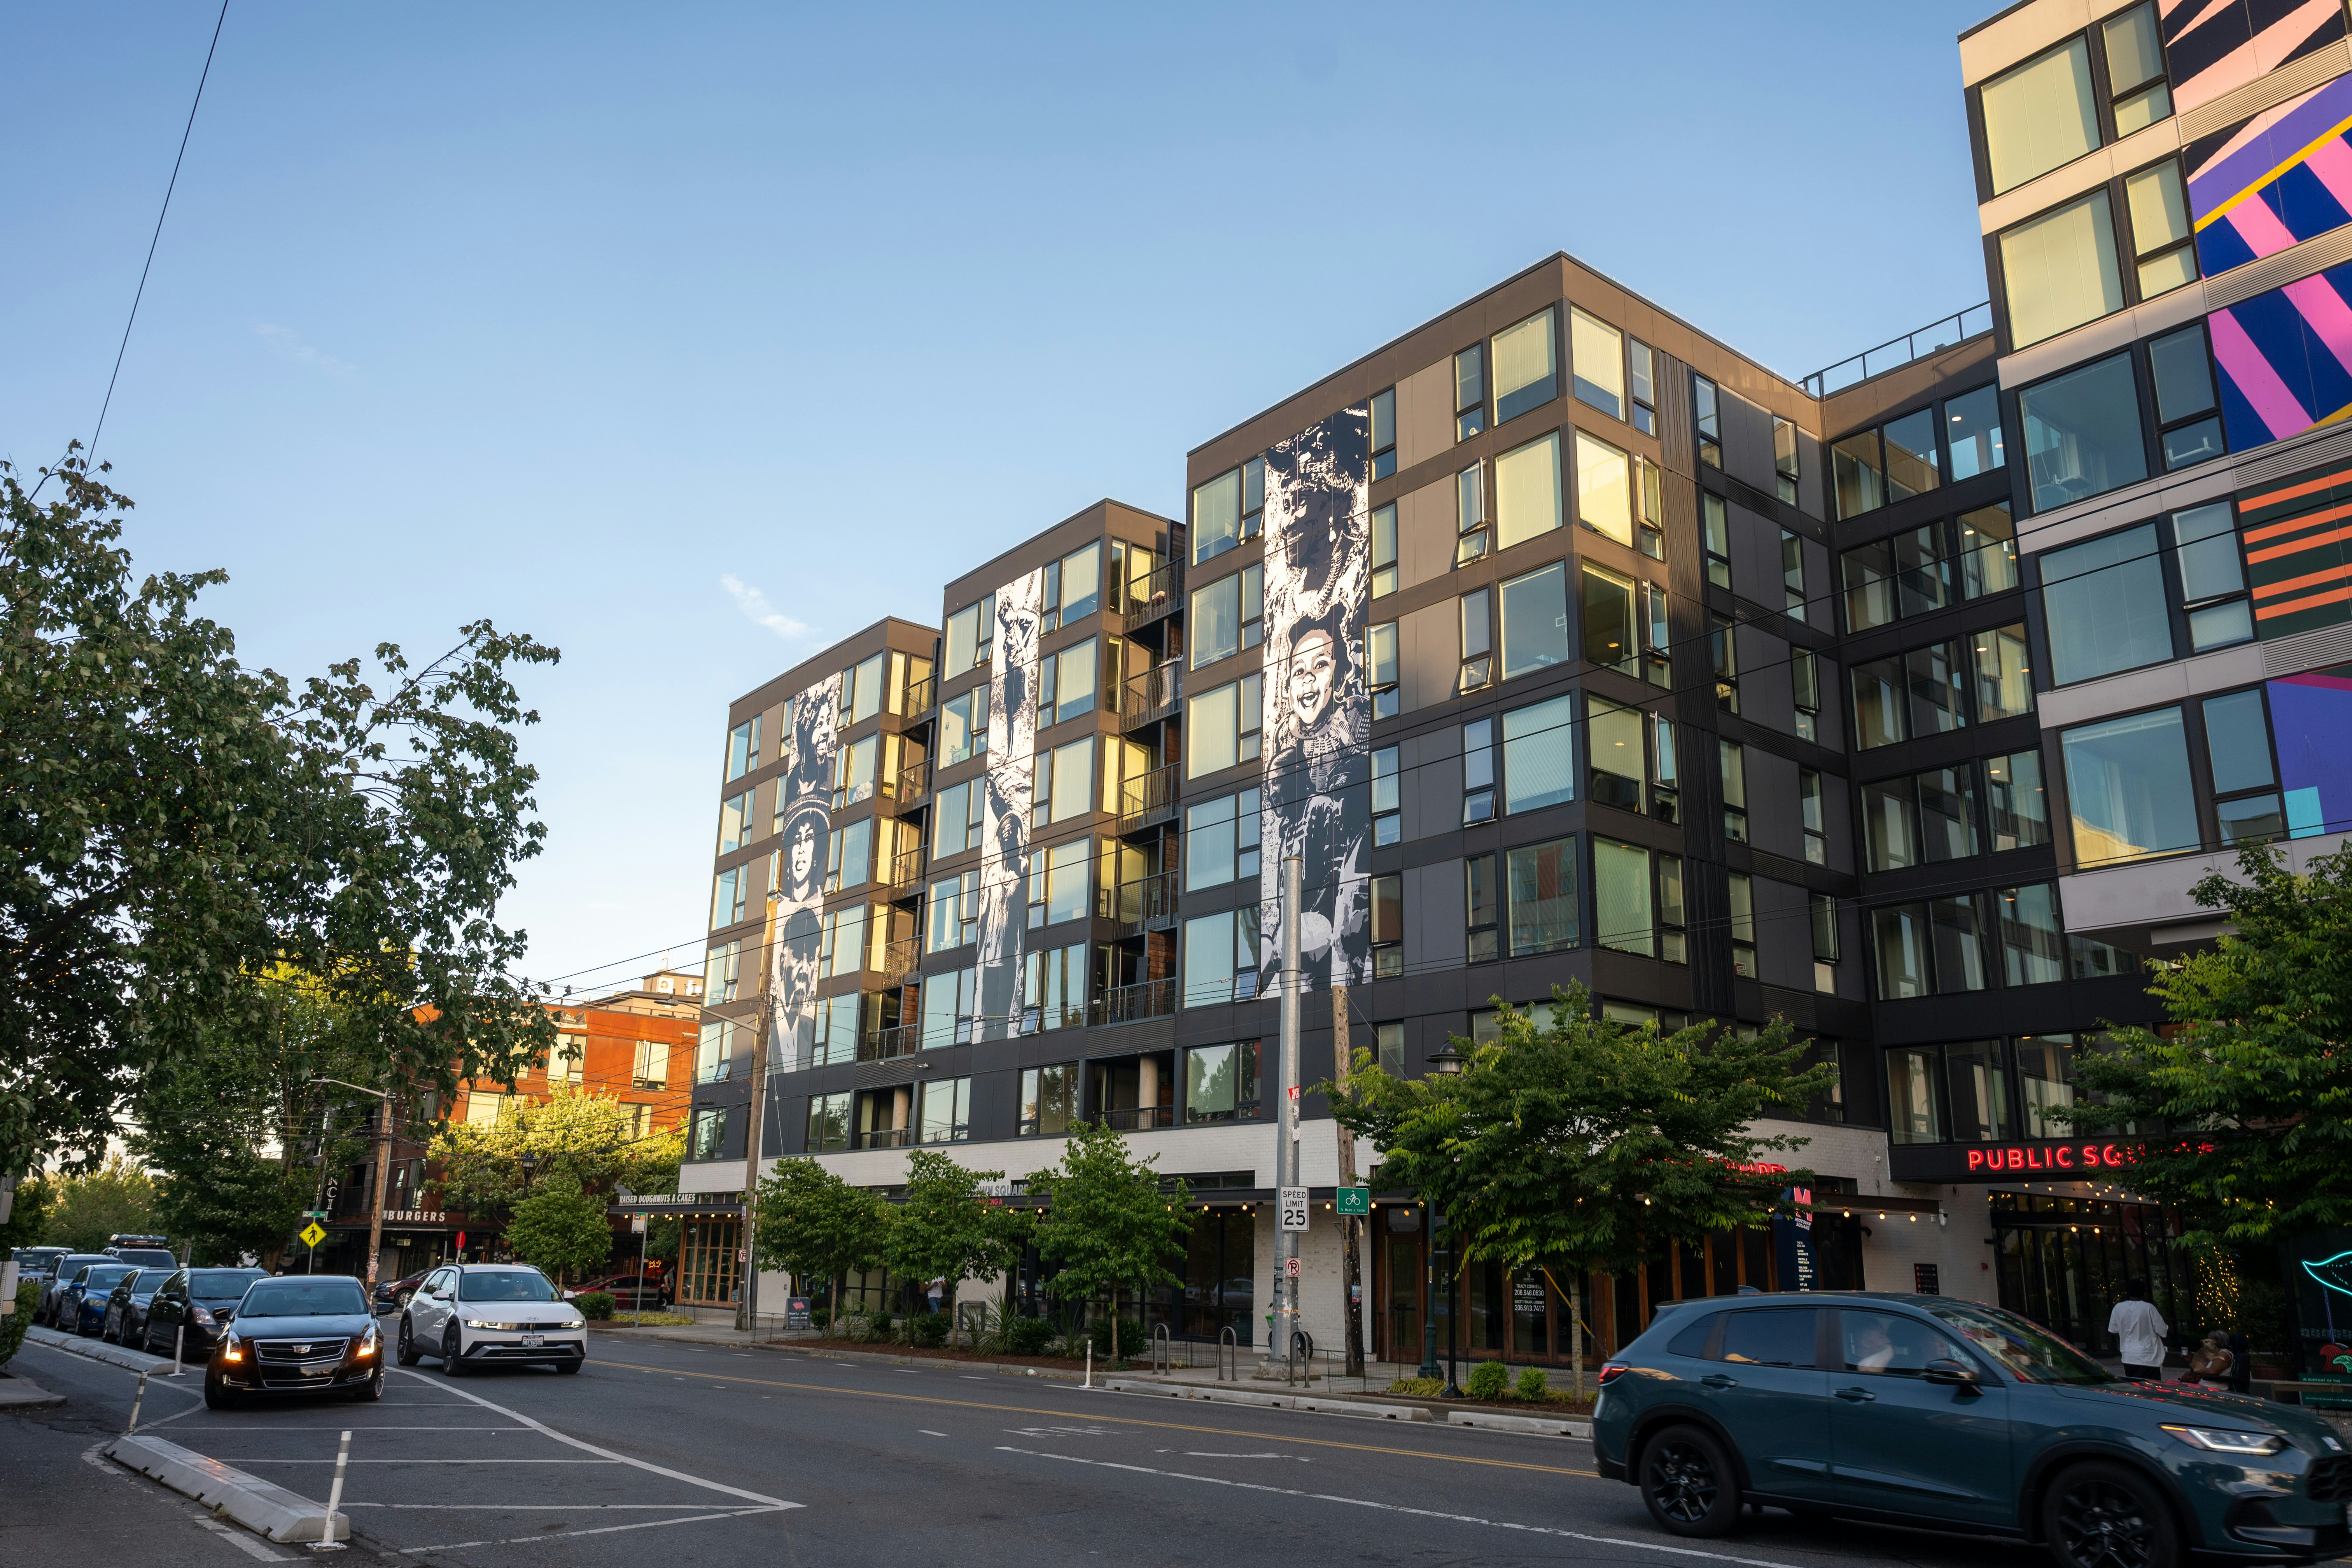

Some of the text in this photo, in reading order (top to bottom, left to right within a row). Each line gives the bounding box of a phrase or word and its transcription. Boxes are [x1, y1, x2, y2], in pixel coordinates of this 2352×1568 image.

[1968, 1147, 2072, 1171] PUBLIC
[639, 1194, 670, 1202] DOUGHNUTS
[677, 1194, 695, 1202] CAKES
[388, 1210, 445, 1222] BURGERS
[1284, 1209, 1306, 1225] 25
[1795, 1217, 1811, 1226] MIDTOWN
[1796, 1222, 1810, 1230] SQUARE
